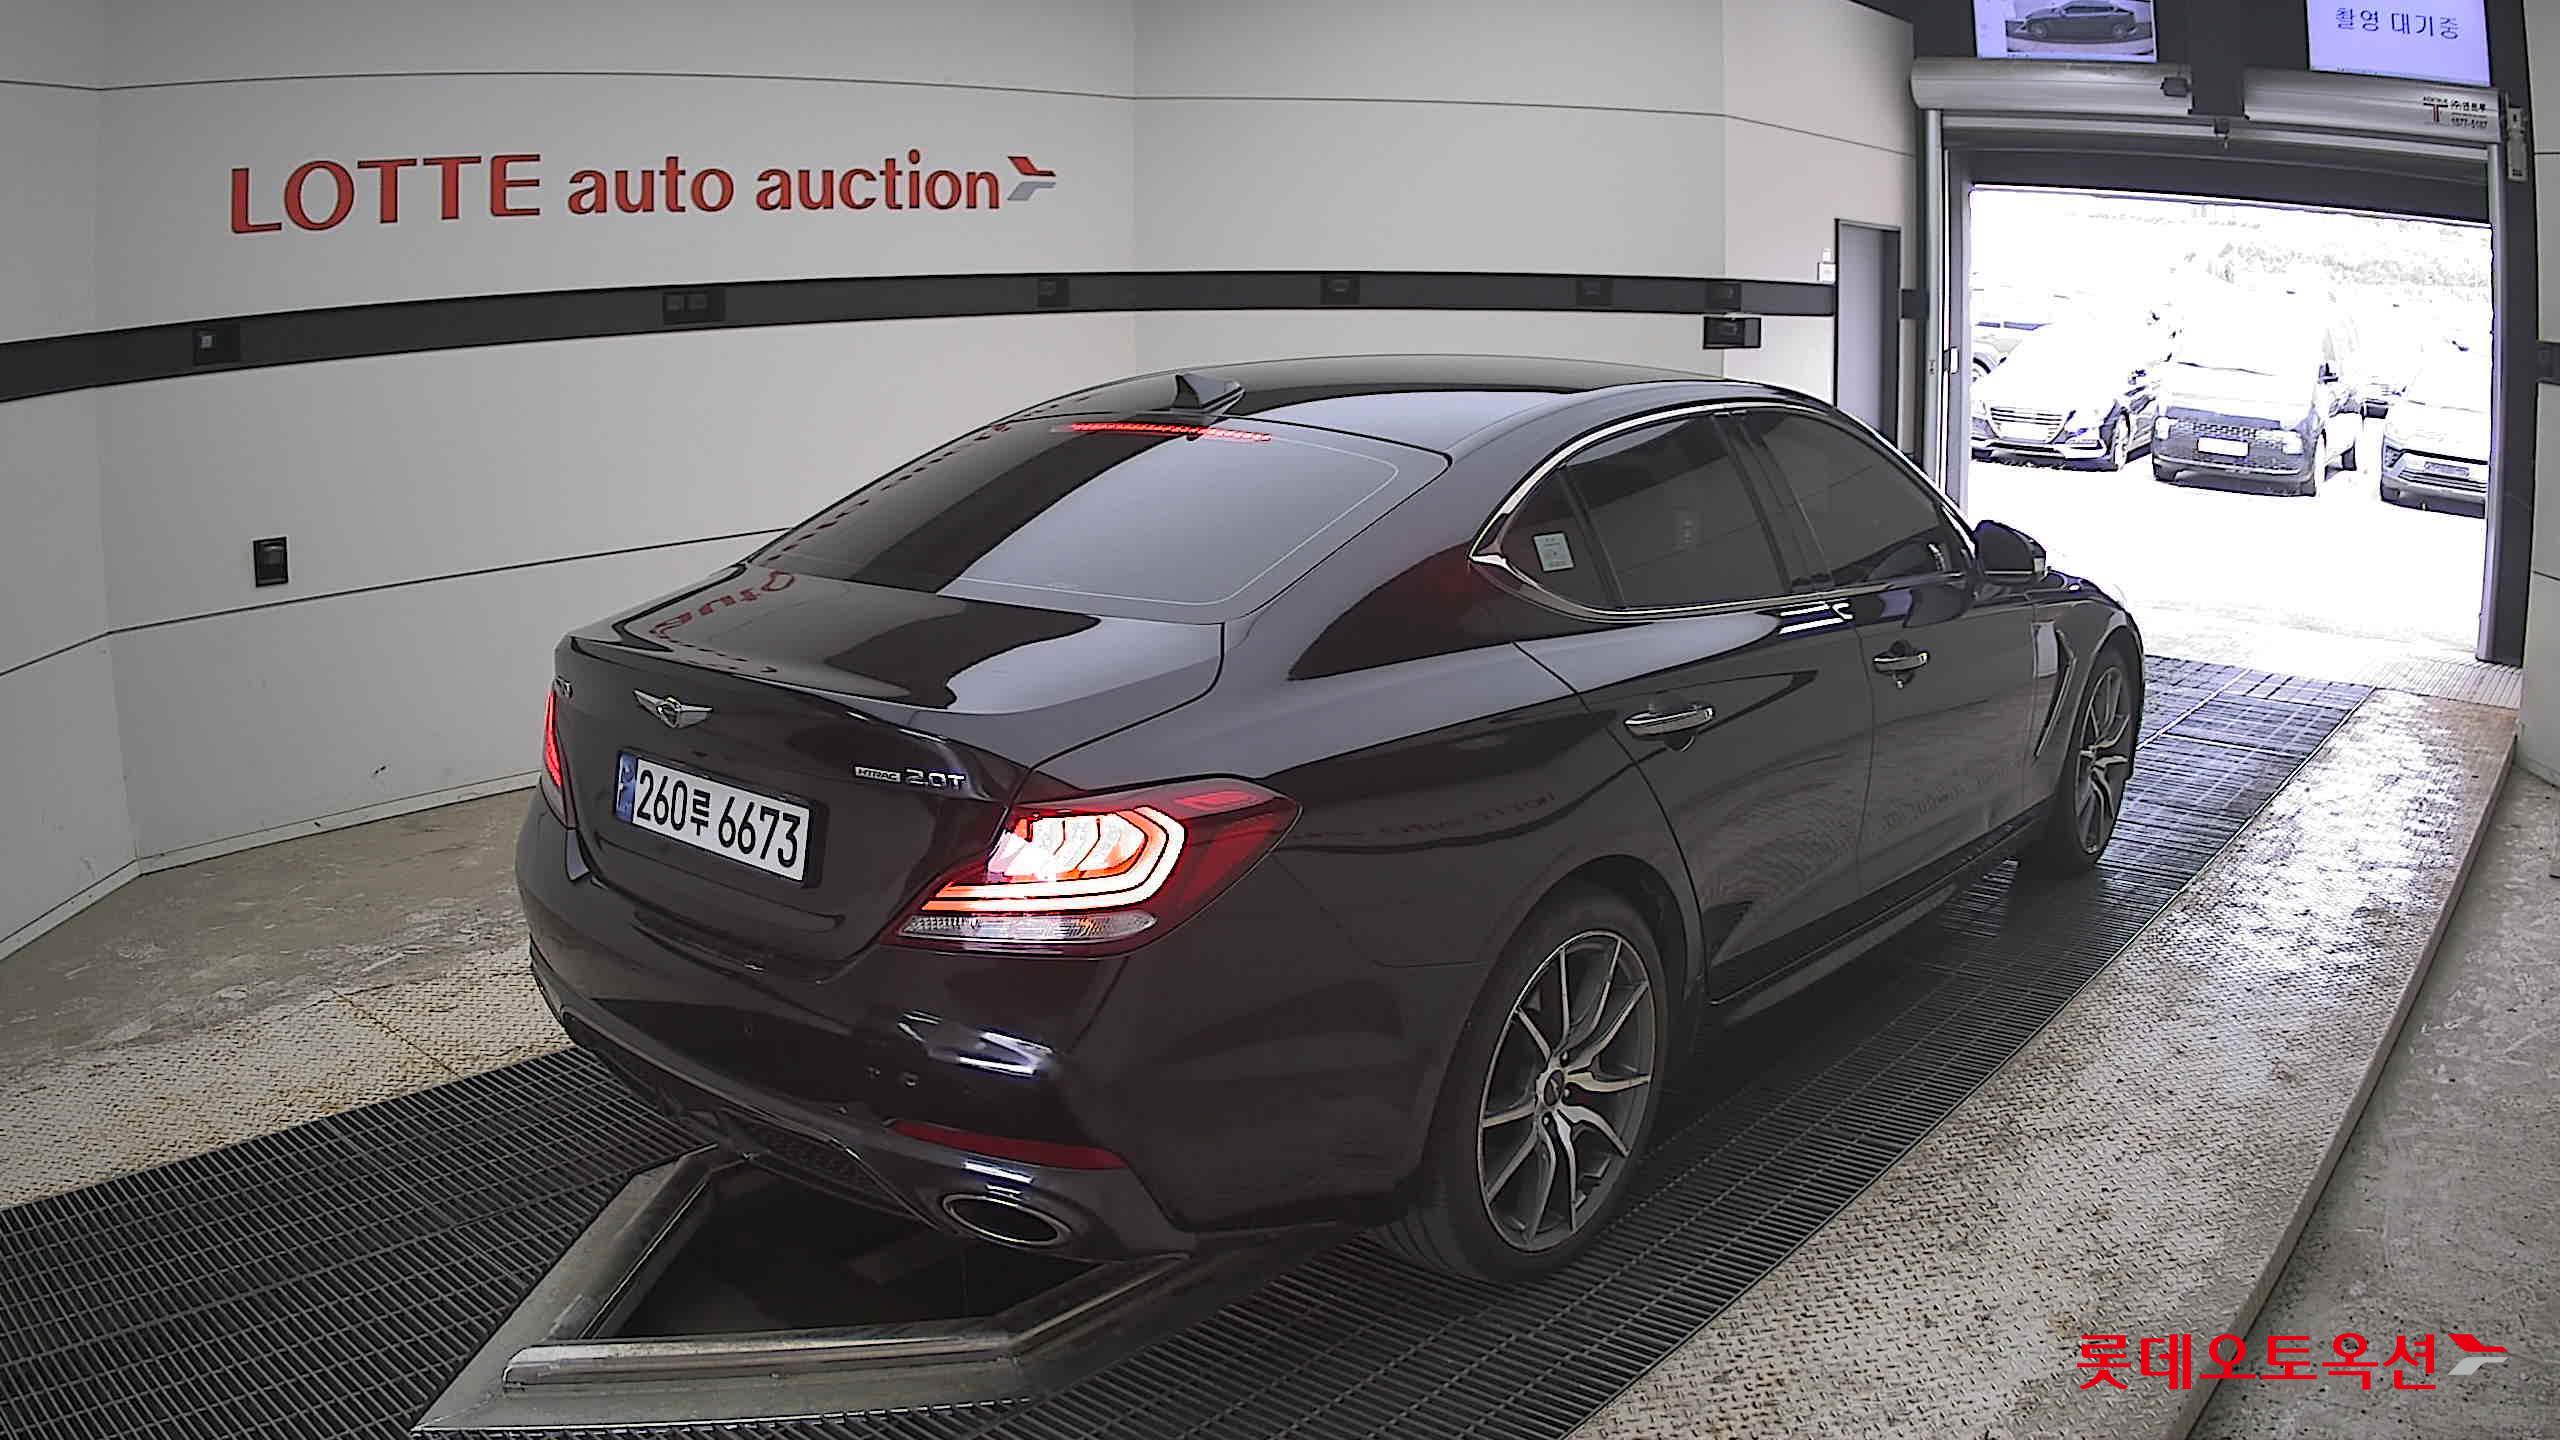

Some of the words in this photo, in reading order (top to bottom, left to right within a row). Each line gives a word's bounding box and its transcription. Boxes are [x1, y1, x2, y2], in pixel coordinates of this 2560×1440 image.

[2336, 7, 2380, 32] 촬영
[2391, 12, 2459, 40] 대기중
[231, 153, 541, 234] LOTTE
[568, 156, 734, 214] auto
[756, 149, 1000, 210] auction
[637, 769, 711, 836] 260루
[718, 795, 801, 868] 6673
